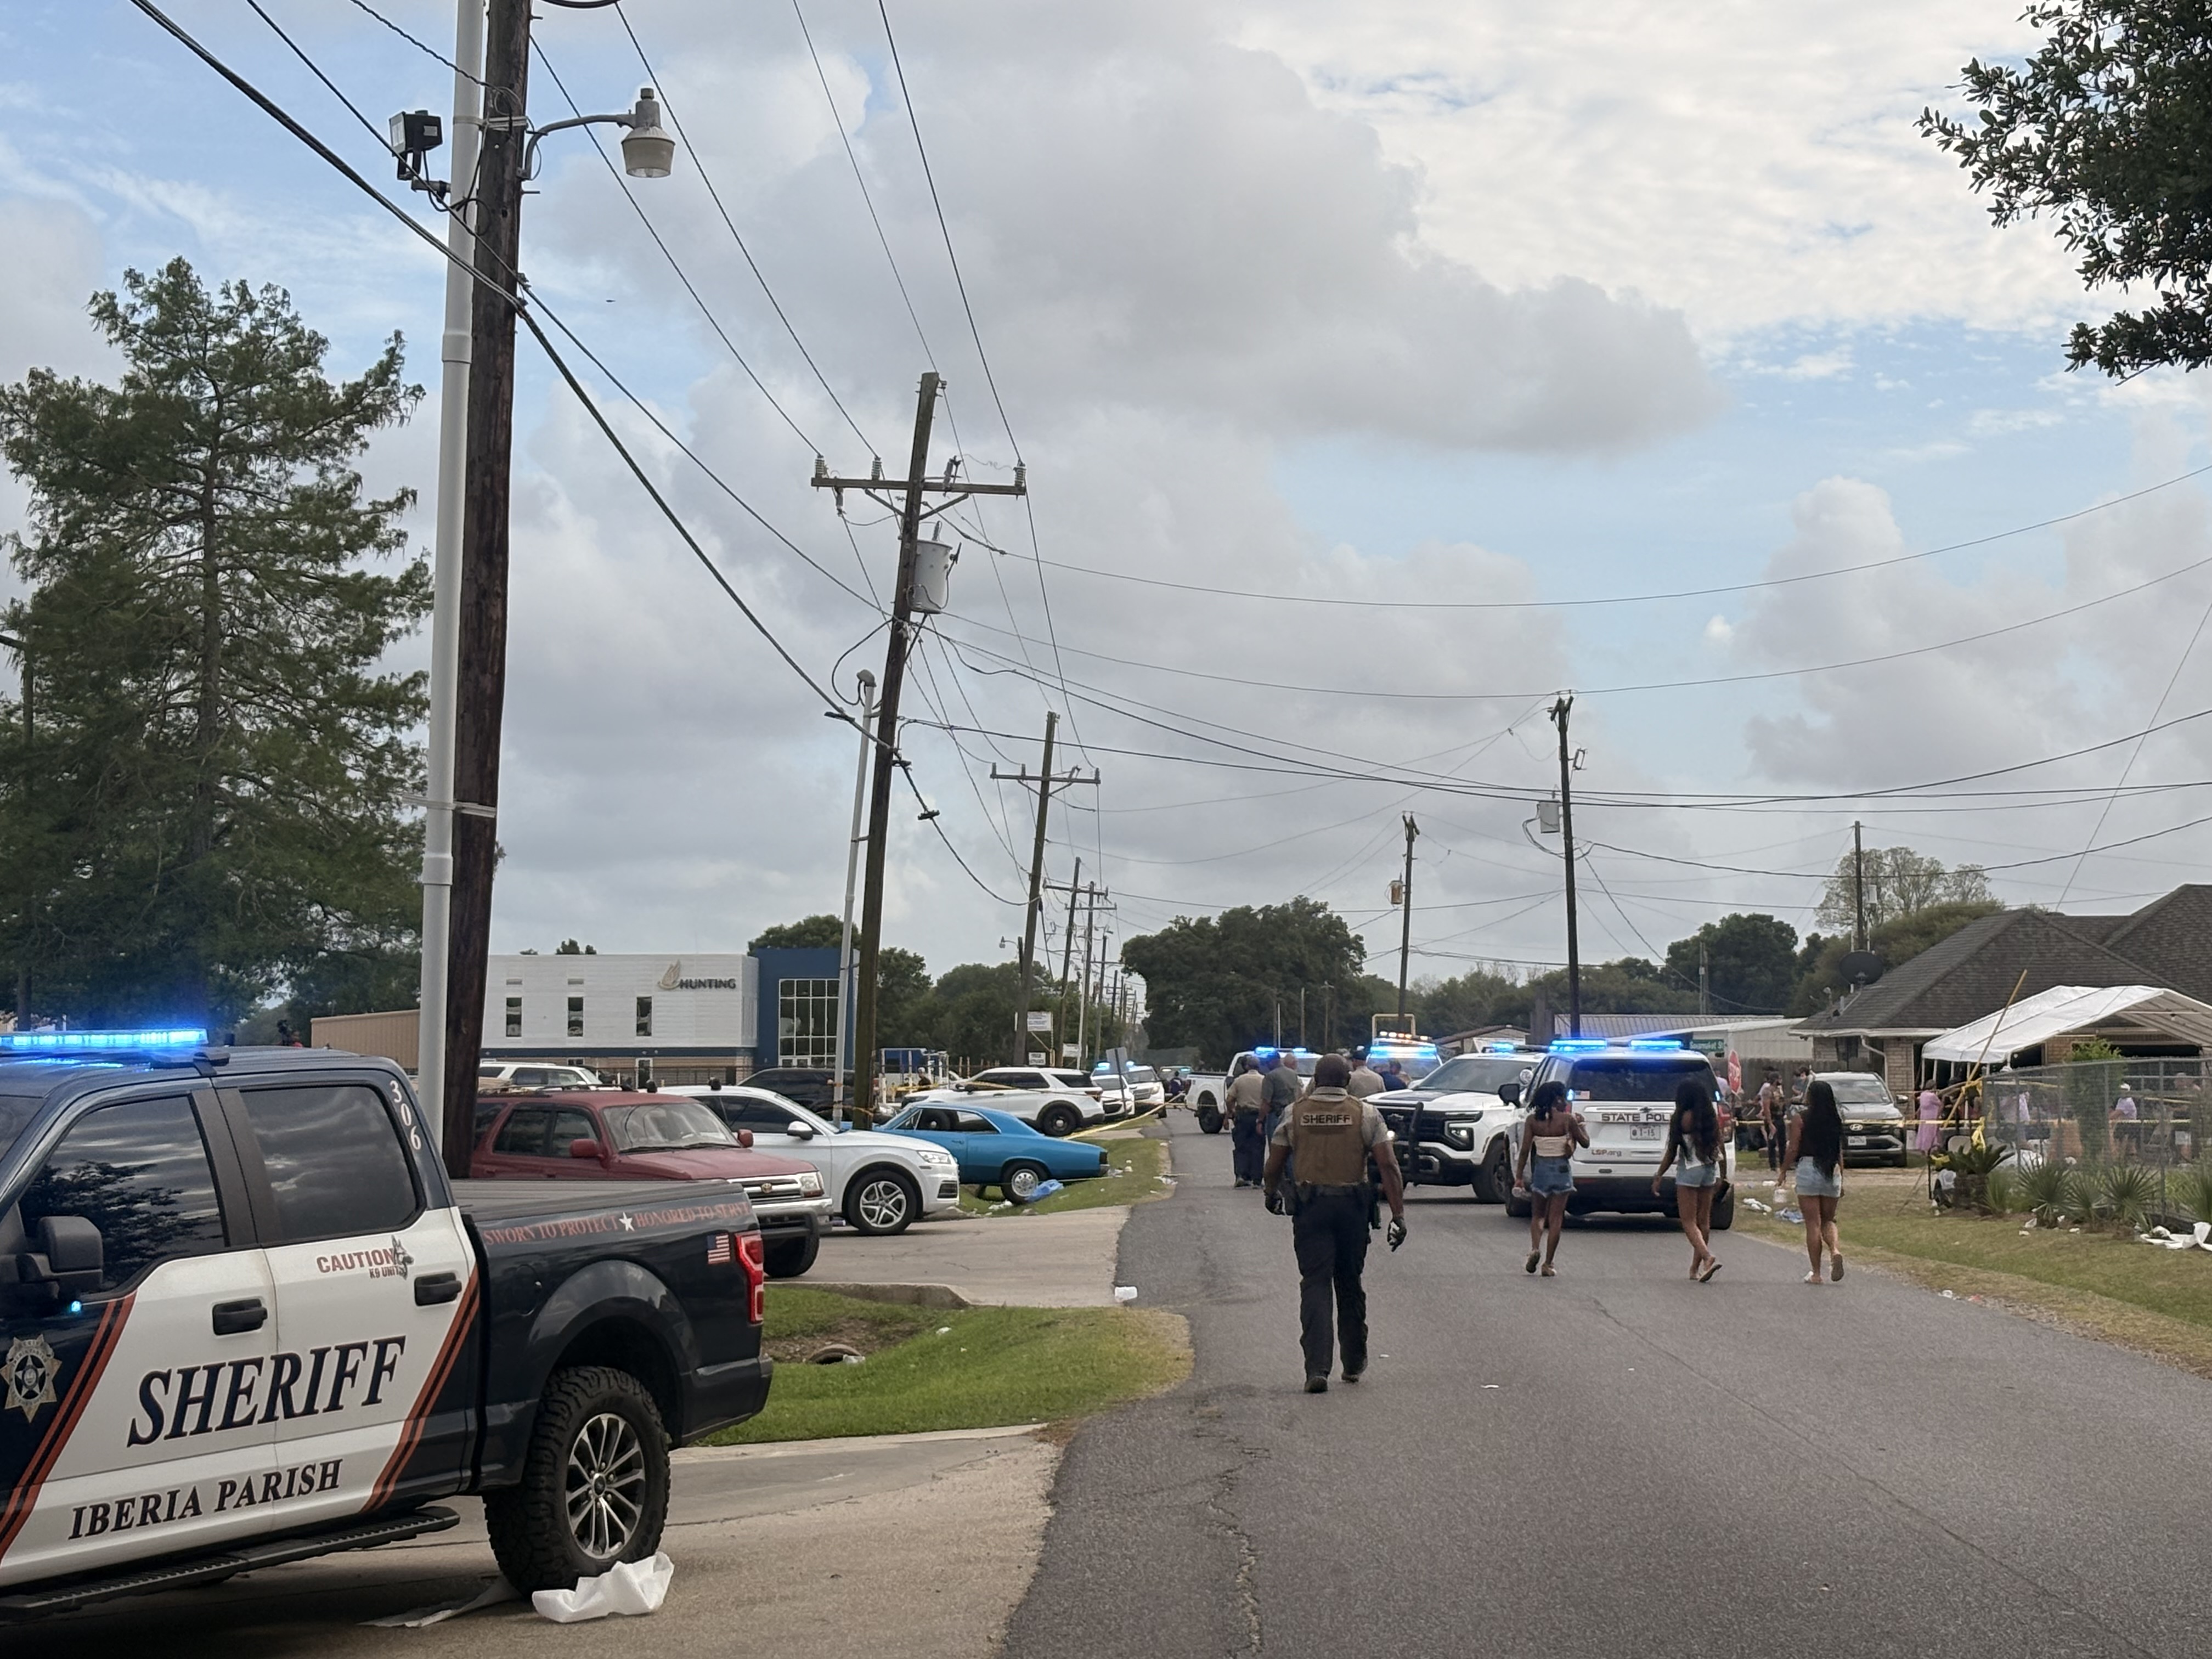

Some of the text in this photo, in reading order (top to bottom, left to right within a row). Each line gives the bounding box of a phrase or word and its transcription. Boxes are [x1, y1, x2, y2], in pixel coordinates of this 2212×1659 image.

[680, 978, 736, 989] HUNTING
[390, 1080, 421, 1150] 306
[1302, 1114, 1351, 1124] SHERIFF
[1601, 1113, 1669, 1121] STATE POL
[1592, 1149, 1622, 1157] LSP.org
[634, 1201, 751, 1228] HONORED TO SERVE
[483, 1215, 618, 1245] SWORN TO PROTECT
[317, 1248, 397, 1273] CAUTION
[369, 1268, 381, 1279] K9
[127, 1335, 407, 1448] SHERIFF
[67, 1458, 343, 1540] IBERIA PARISH
